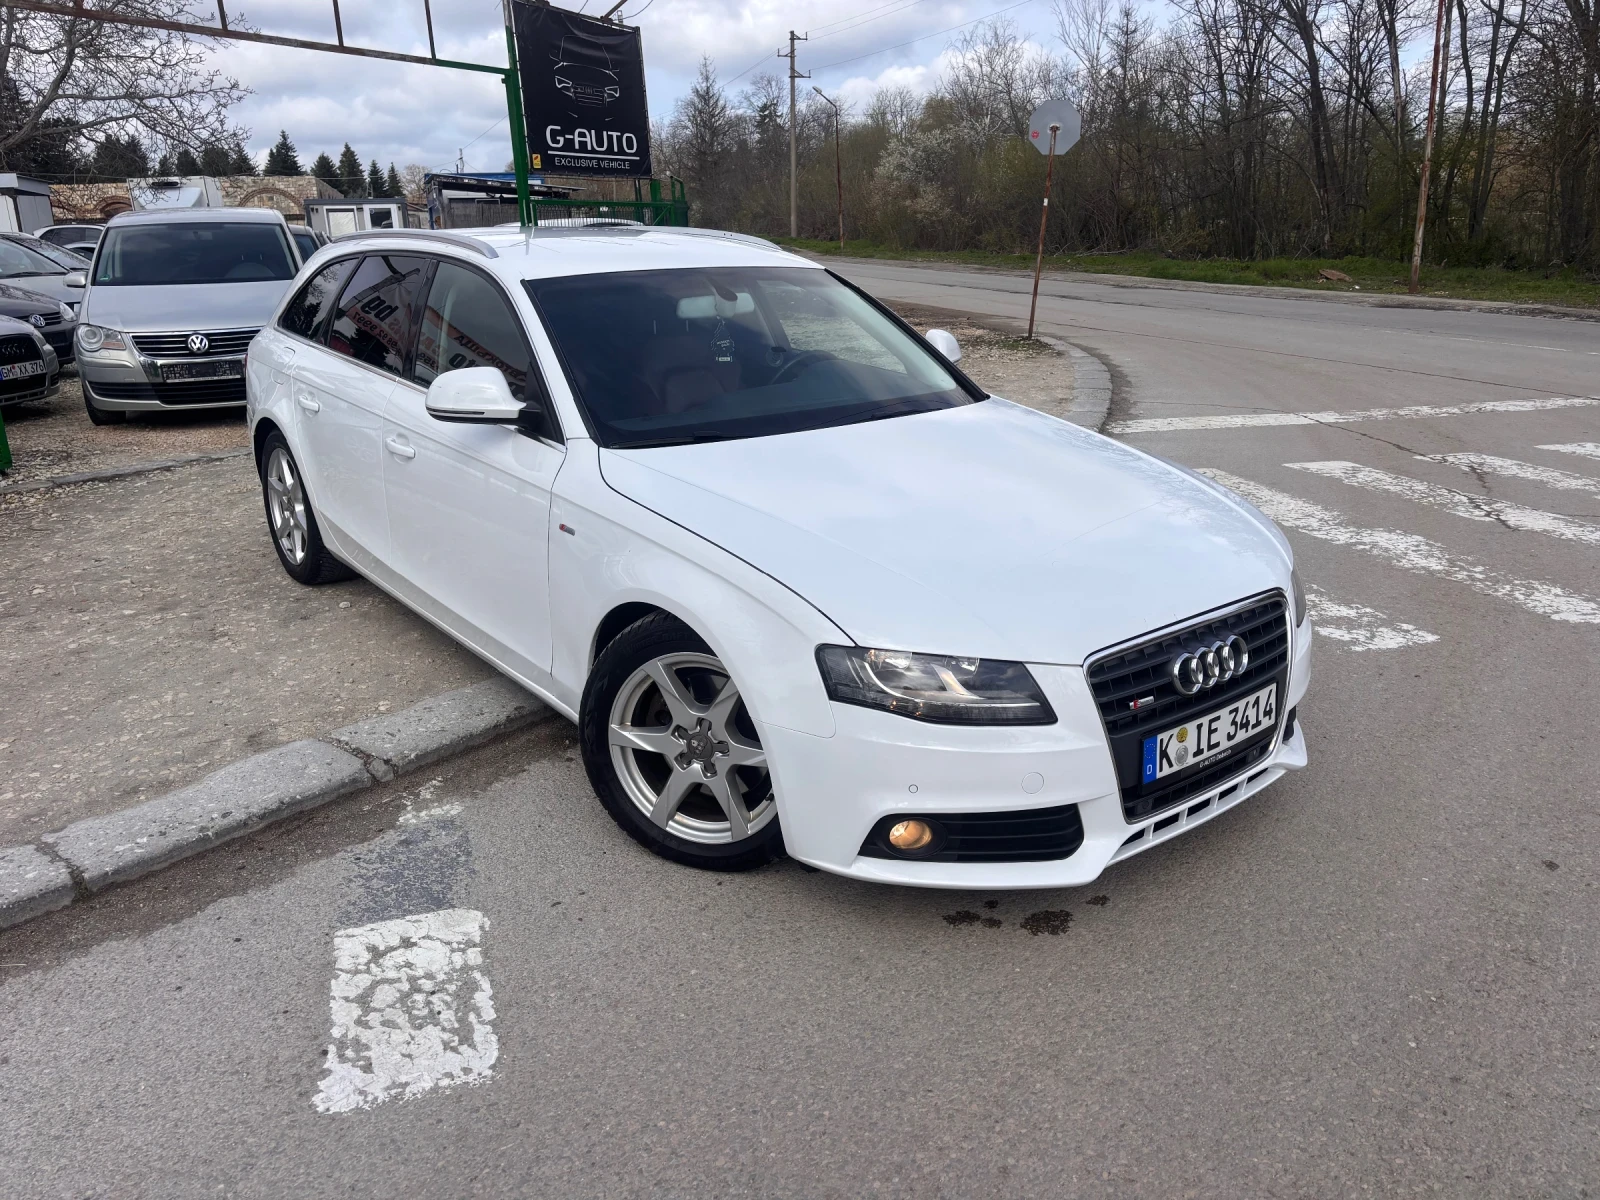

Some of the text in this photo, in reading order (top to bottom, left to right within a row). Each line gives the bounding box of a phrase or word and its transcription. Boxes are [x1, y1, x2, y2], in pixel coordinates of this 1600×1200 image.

[545, 125, 638, 154] G-AUTO
[554, 157, 599, 169] EXCLUSIVE
[599, 159, 631, 170] VEHICLE
[1, 360, 45, 379] GM XX 376
[1157, 688, 1275, 774] K IE 3414
[1146, 763, 1153, 775] D
